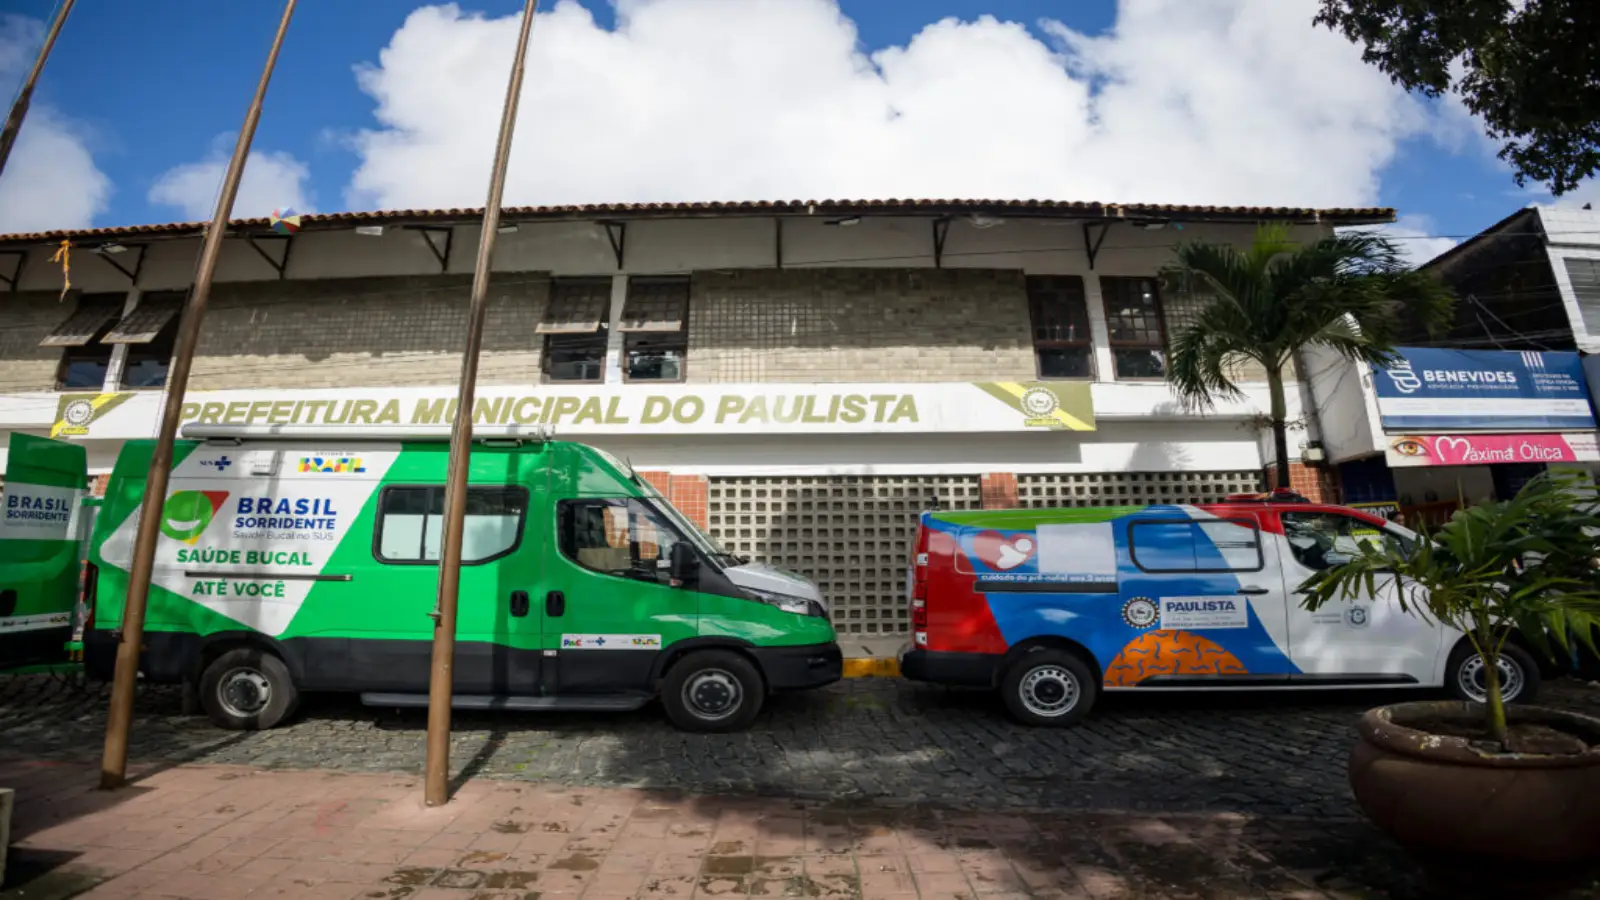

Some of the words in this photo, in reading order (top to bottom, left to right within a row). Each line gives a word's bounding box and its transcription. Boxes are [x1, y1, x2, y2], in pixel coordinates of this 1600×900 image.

[1423, 369, 1516, 383] BENEVIDES
[177, 399, 400, 425] PREFEITURA
[640, 395, 705, 424] DO
[714, 394, 919, 423] PAULISTA
[1519, 440, 1563, 460] Ótica
[297, 457, 367, 473] BRASIL
[7, 494, 69, 512] BRASIL
[236, 497, 338, 516] BRASIL
[6, 509, 70, 521] SORRIDENTE
[234, 517, 336, 530] SORRIDENTE
[176, 545, 241, 564] SAÚDE
[245, 550, 313, 566] BUCAL
[192, 577, 228, 596] ATÉ
[232, 580, 286, 597] VOCÊ
[1166, 600, 1236, 612] PAULISTA
